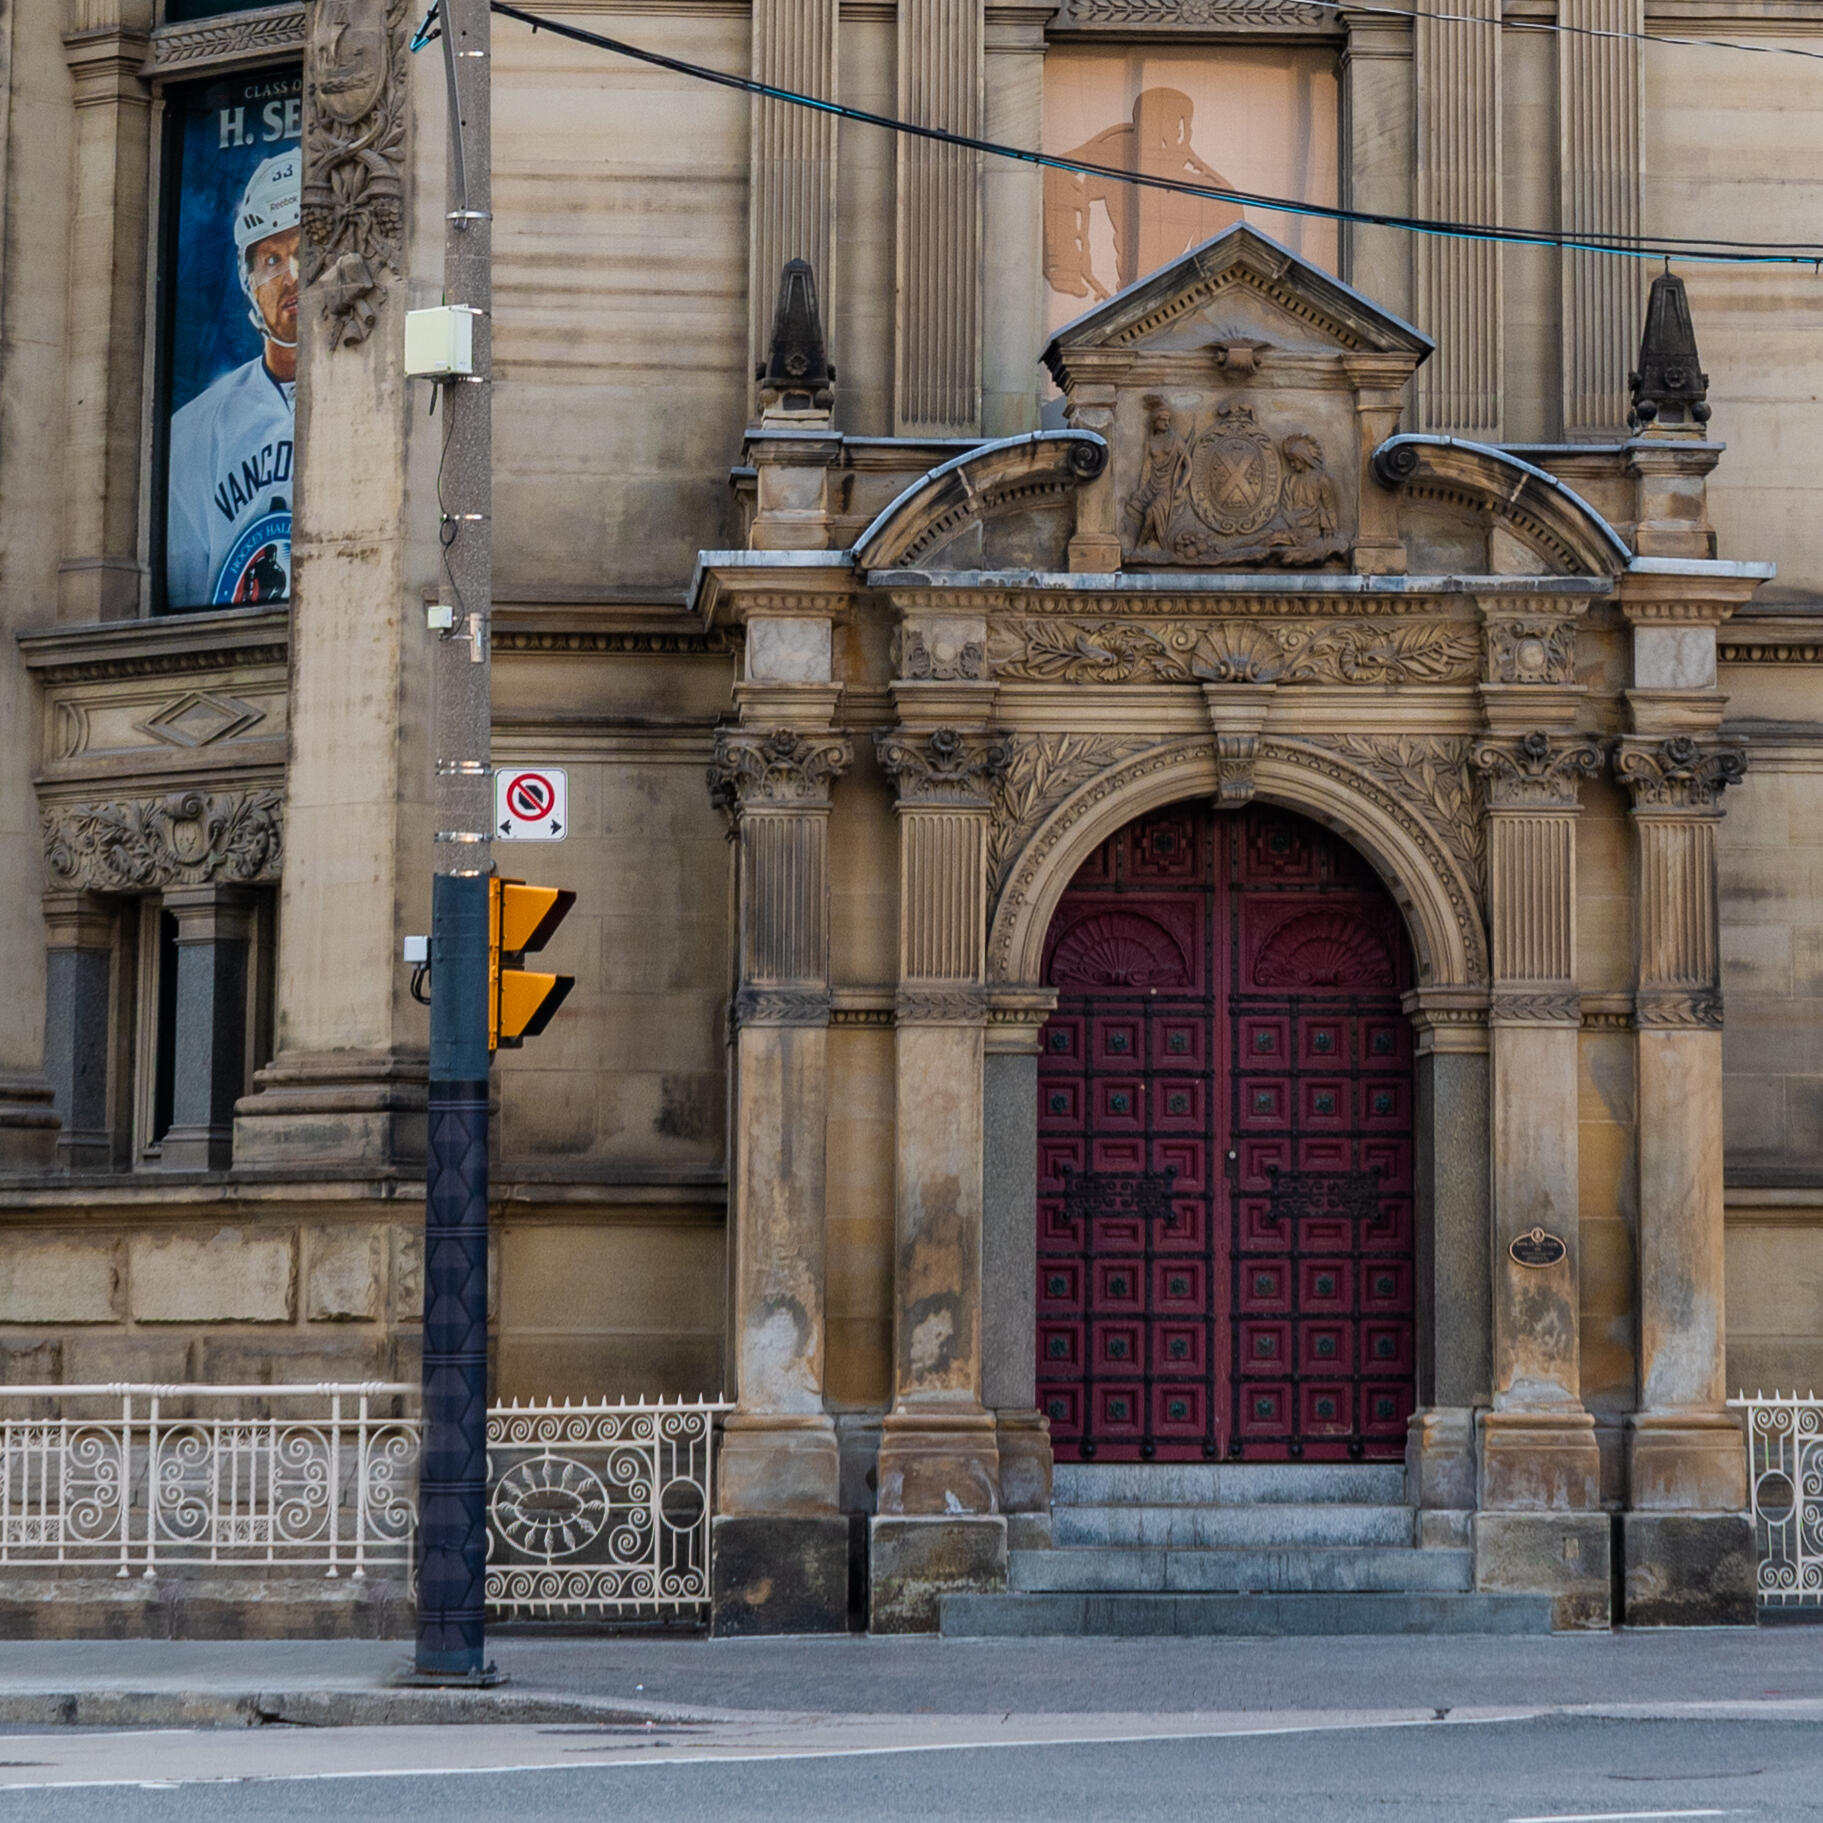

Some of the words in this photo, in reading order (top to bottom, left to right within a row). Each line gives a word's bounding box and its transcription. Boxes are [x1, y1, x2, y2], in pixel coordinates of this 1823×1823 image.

[244, 79, 287, 99] CLASS
[219, 106, 254, 149] H.
[231, 529, 265, 574] HOCKEY
